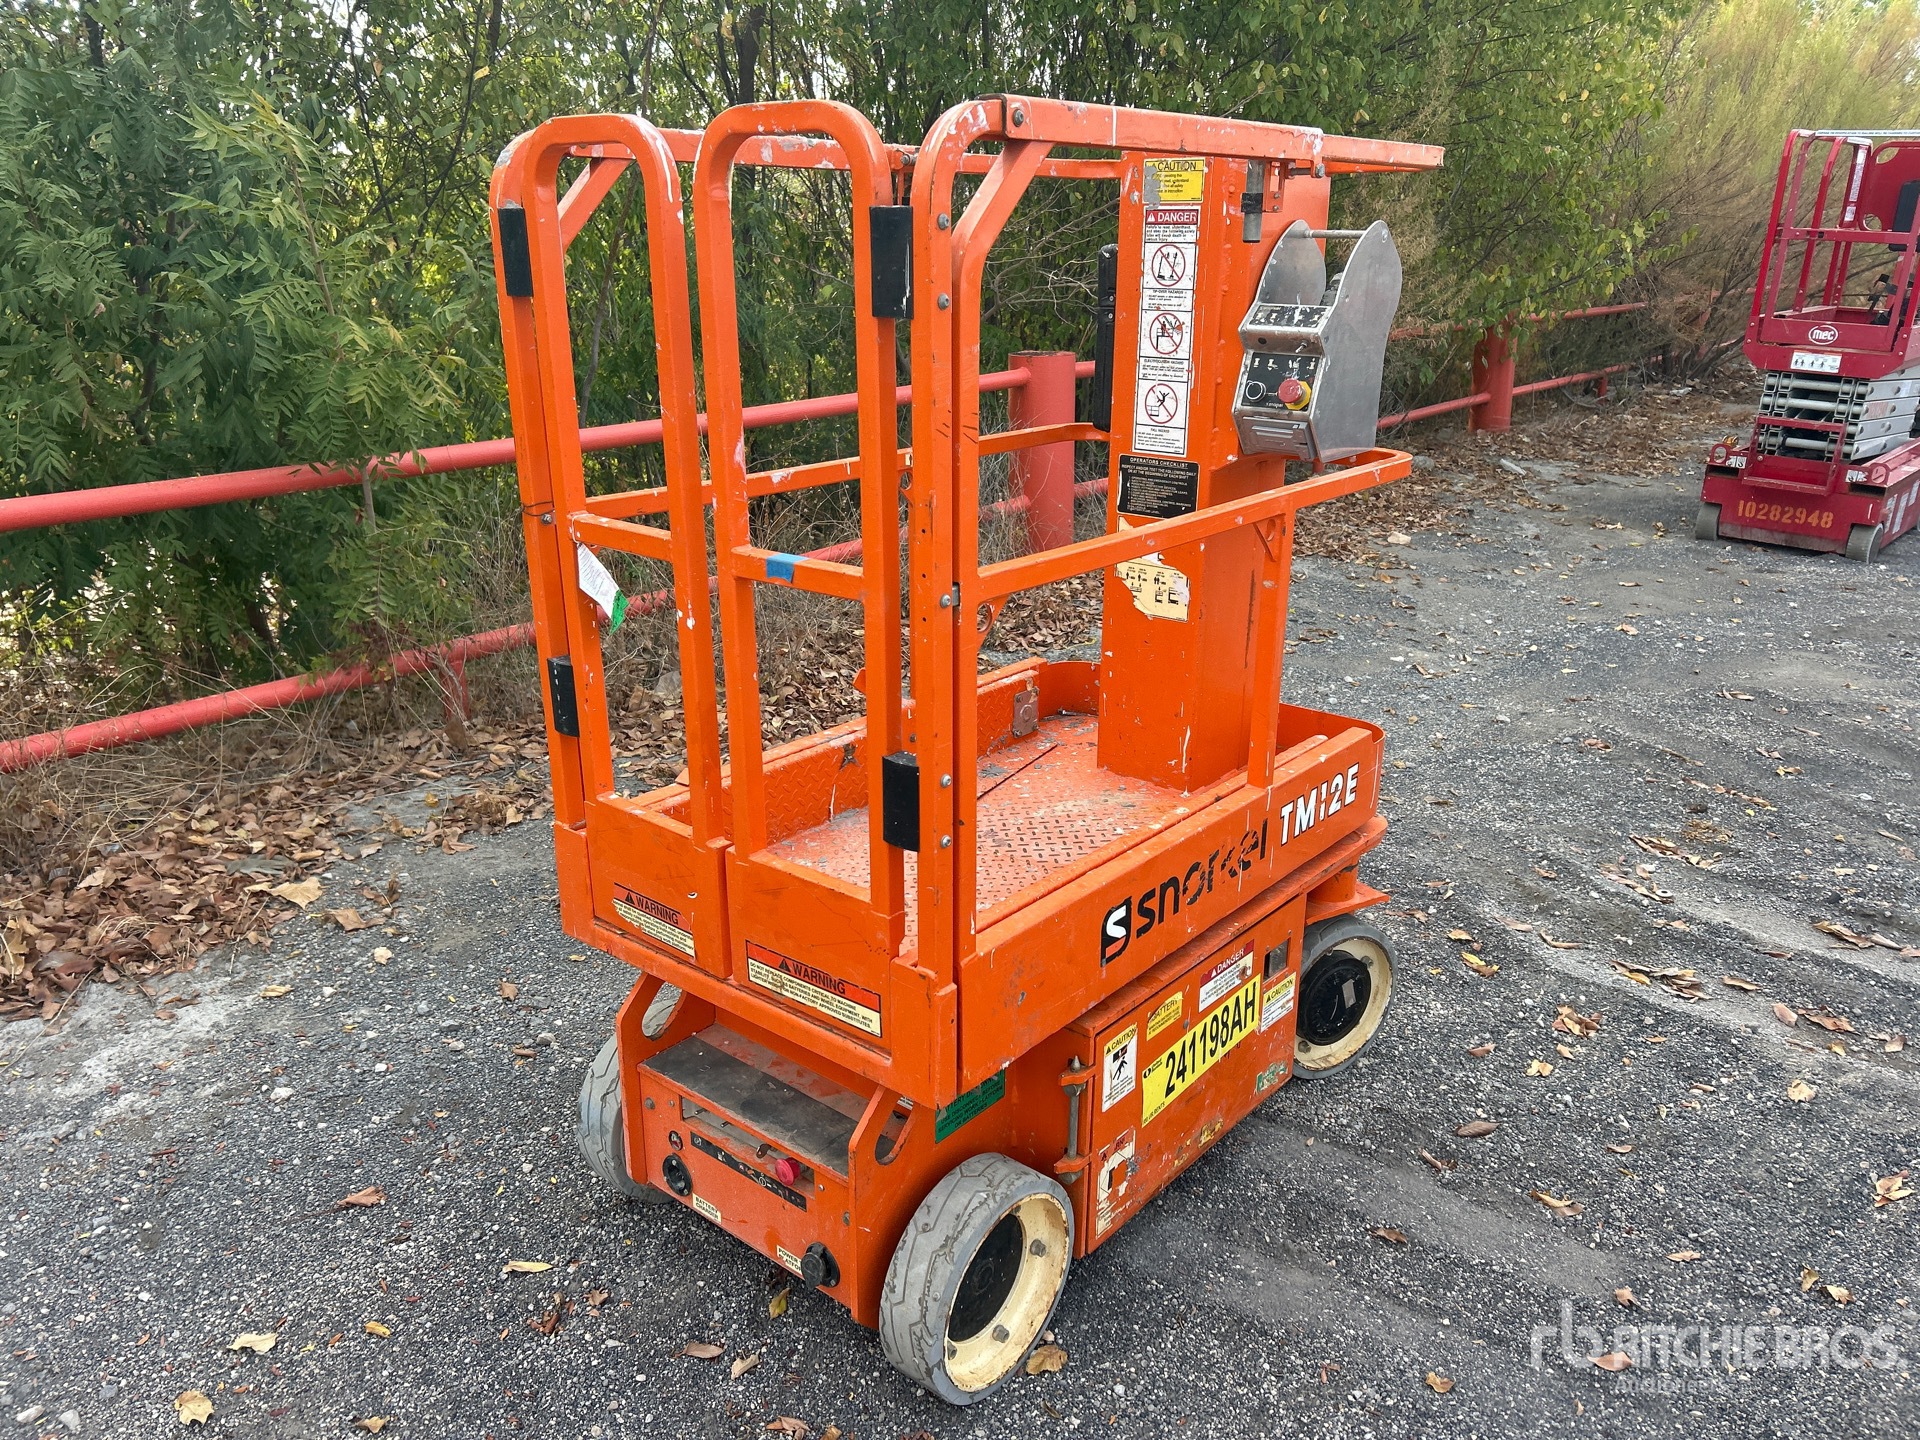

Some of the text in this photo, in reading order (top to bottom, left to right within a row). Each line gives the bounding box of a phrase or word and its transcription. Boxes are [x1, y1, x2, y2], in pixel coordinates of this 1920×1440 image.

[1157, 162, 1196, 171] CAUTION
[1158, 212, 1197, 222] DANGER
[1130, 457, 1159, 465] OPERATORS
[1738, 500, 1834, 529] 10282948
[1280, 762, 1360, 846] TM12E
[635, 895, 678, 925] WARNING
[1217, 947, 1243, 973] DANGER
[792, 962, 845, 995] WARNING
[1271, 979, 1293, 999] CAUTION
[1111, 1025, 1138, 1050] CAUTION
[1165, 981, 1257, 1099] 241198AH
[695, 1196, 719, 1214] BATTERY
[778, 1247, 799, 1263] POWER
